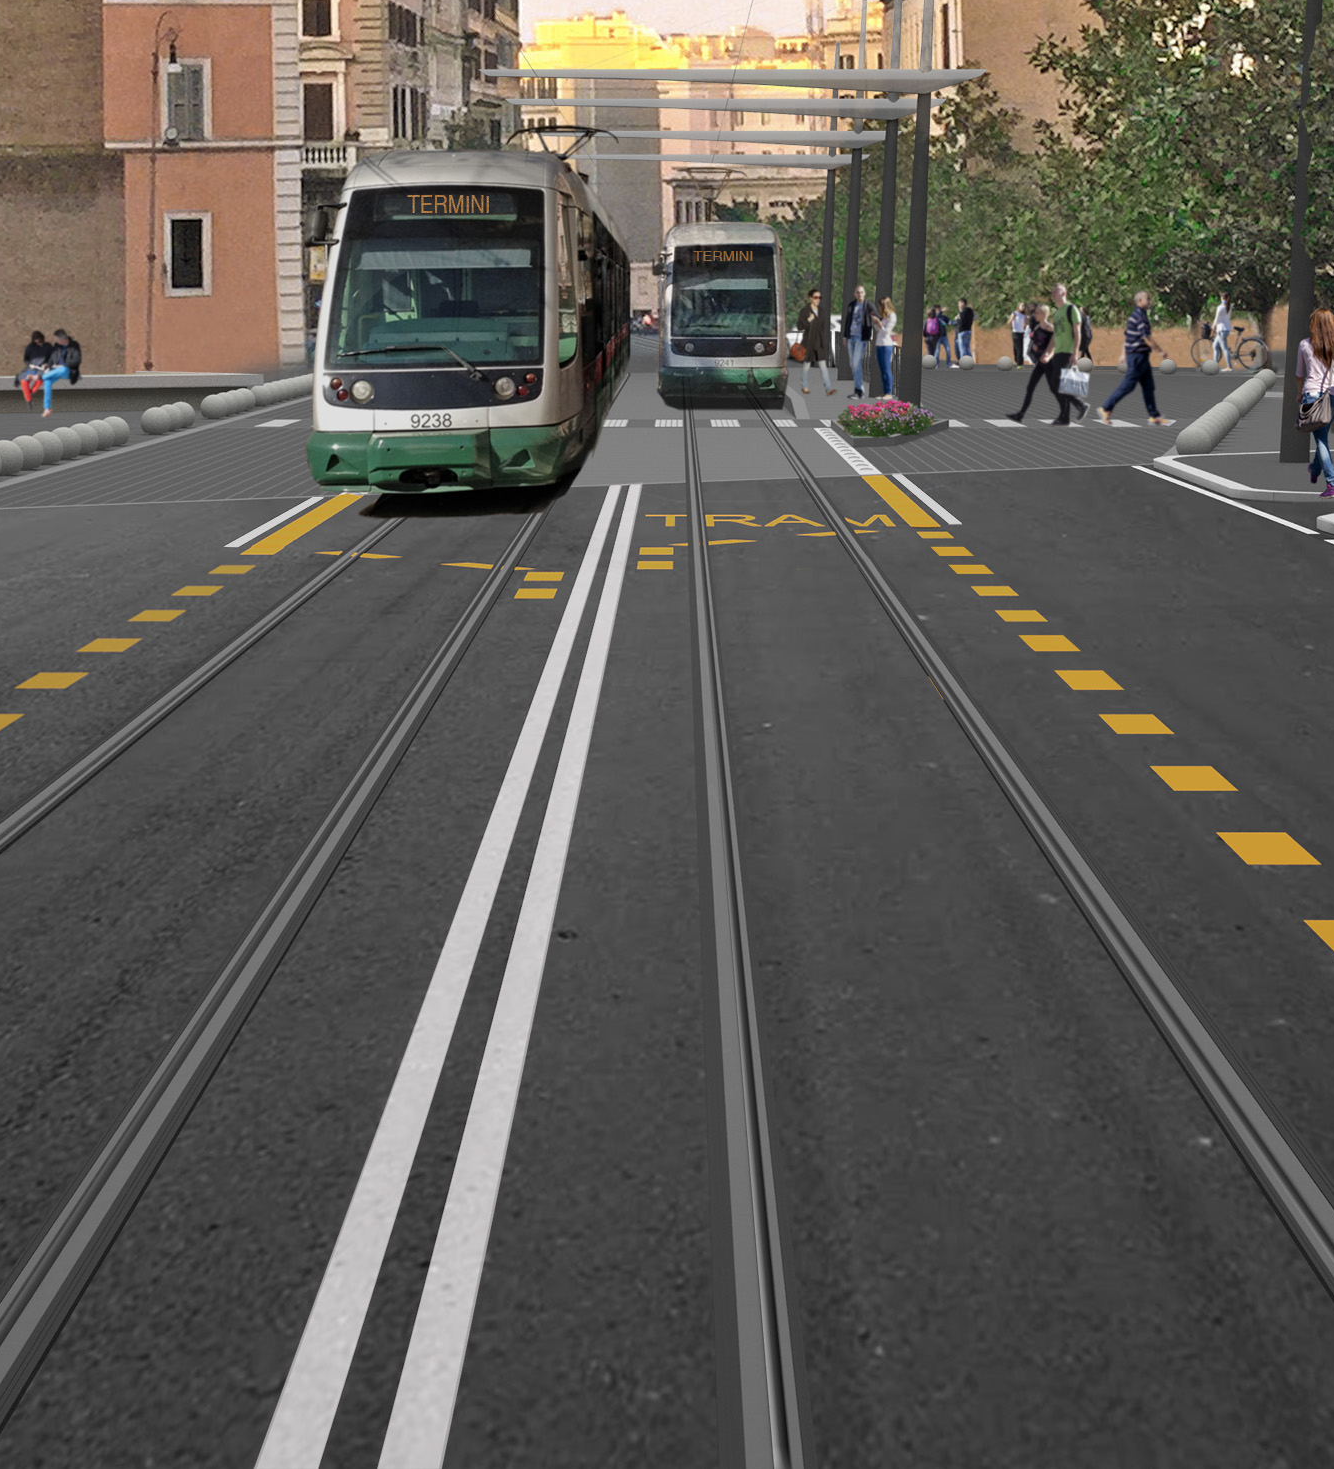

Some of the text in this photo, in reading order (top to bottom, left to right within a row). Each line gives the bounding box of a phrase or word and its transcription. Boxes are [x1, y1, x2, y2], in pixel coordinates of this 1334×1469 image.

[407, 194, 490, 214] TERMINI
[693, 250, 754, 262] TERMINI
[410, 413, 453, 429] 9238
[645, 514, 896, 528] TRAM
